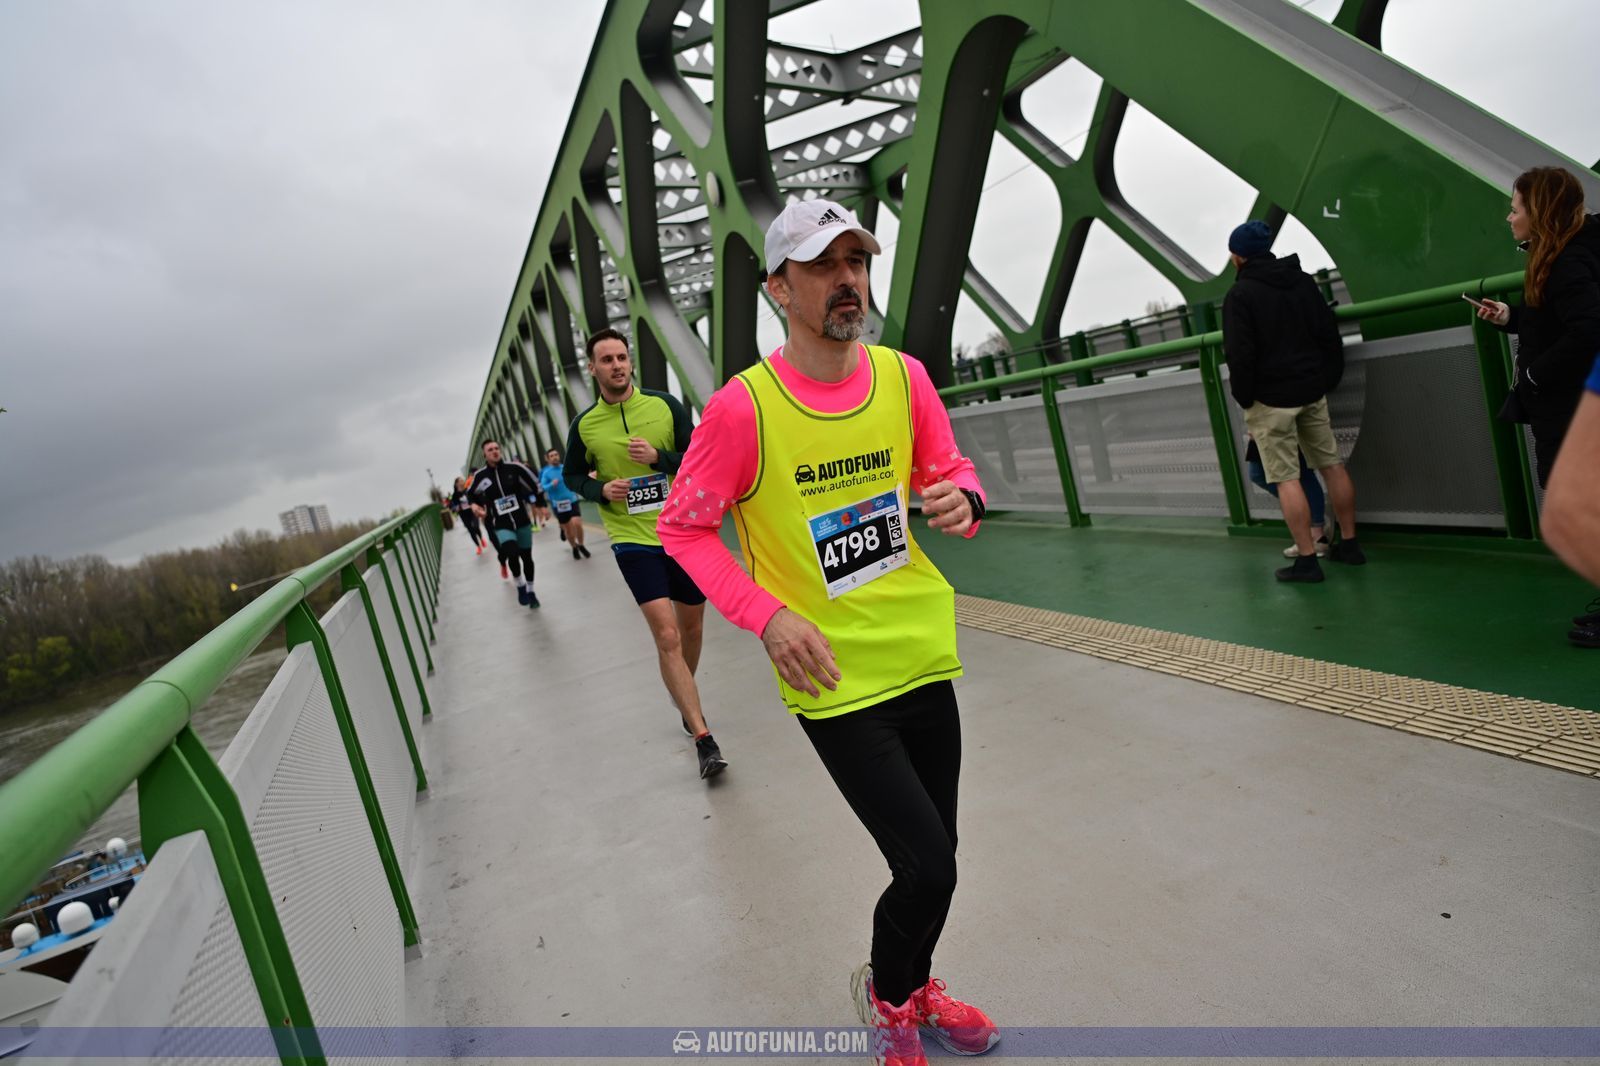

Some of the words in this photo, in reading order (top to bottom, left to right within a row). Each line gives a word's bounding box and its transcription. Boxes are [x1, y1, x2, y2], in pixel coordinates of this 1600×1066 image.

[818, 448, 891, 482] AUTOFUNIA
[627, 487, 659, 503] 3935
[823, 525, 880, 569] 4798
